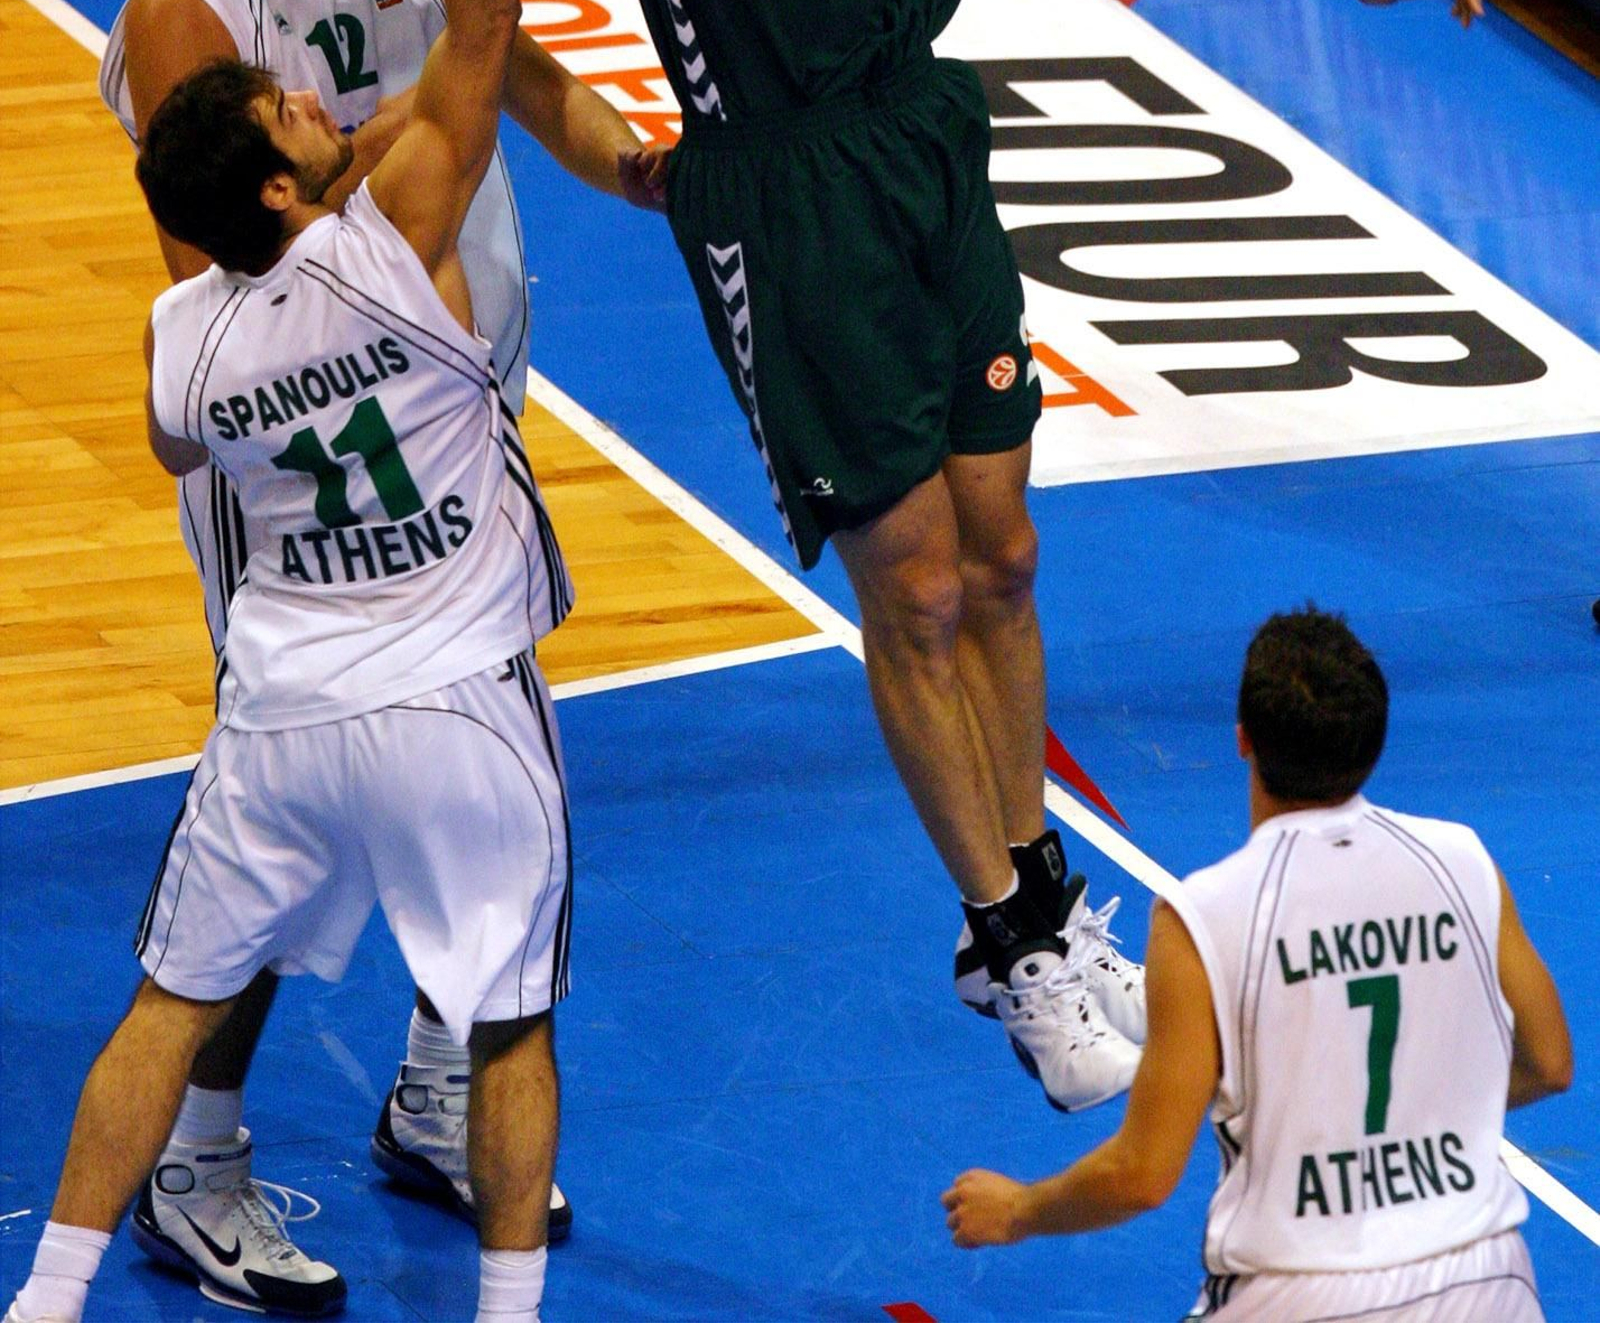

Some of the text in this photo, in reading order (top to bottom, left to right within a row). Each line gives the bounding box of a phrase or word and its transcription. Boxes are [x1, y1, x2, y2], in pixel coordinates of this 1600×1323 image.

[305, 12, 379, 95] 12
[976, 56, 1548, 398] FOUR
[207, 337, 411, 442] SPANOULIS
[270, 394, 426, 530] 11
[280, 494, 474, 586] ATHENS
[1276, 911, 1460, 985] LAKOVIC
[1346, 974, 1400, 1137] 7
[1294, 1131, 1476, 1219] ATHENS
